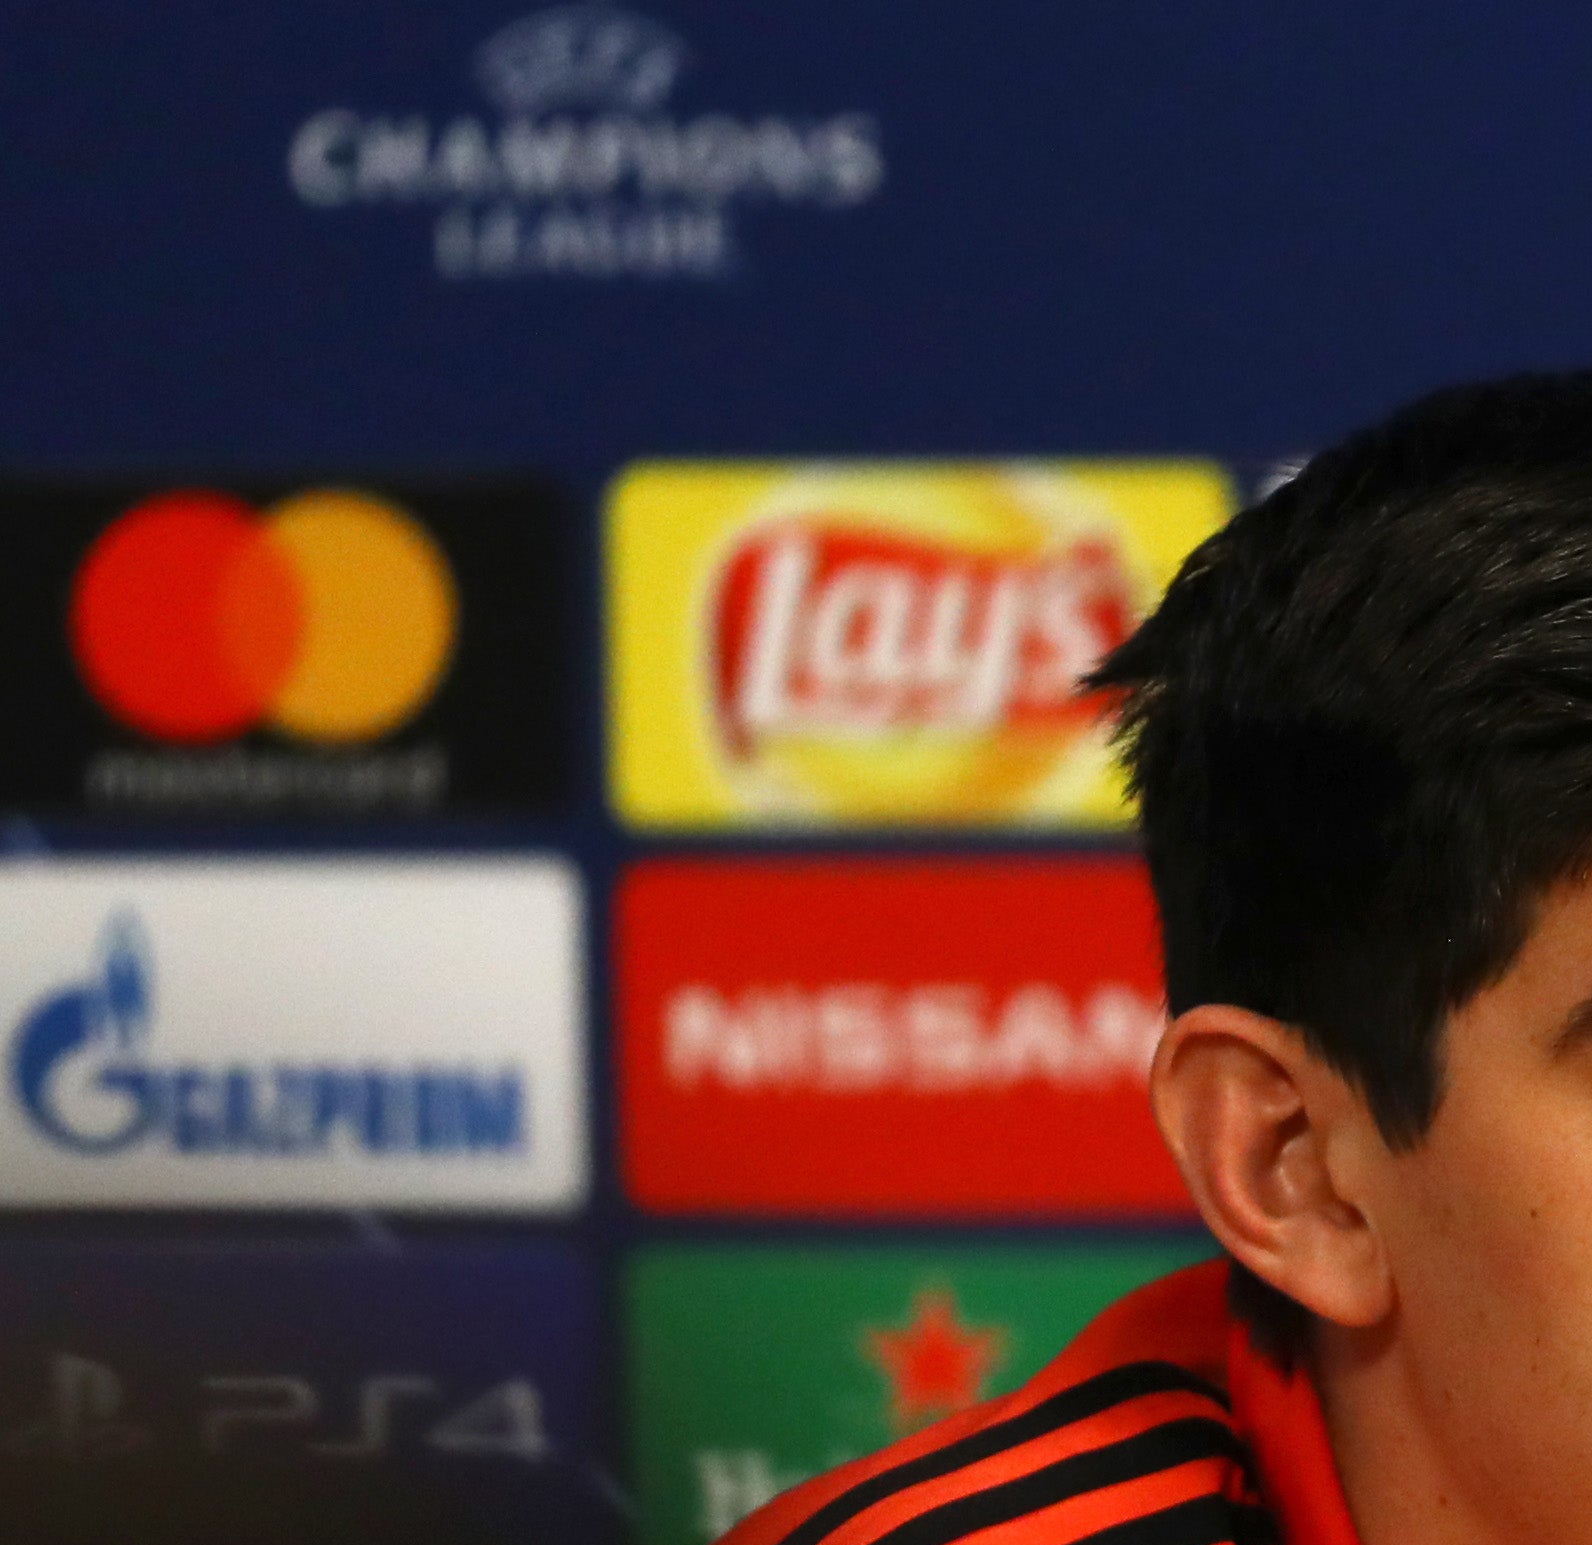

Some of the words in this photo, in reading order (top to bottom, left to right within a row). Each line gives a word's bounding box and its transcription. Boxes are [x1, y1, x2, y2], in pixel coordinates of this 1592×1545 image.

[290, 110, 884, 205] CHAMPIONS
[16, 985, 526, 1158] GAZPROM
[660, 980, 1168, 1092] NISSAN
[200, 1372, 552, 1460] PS4
